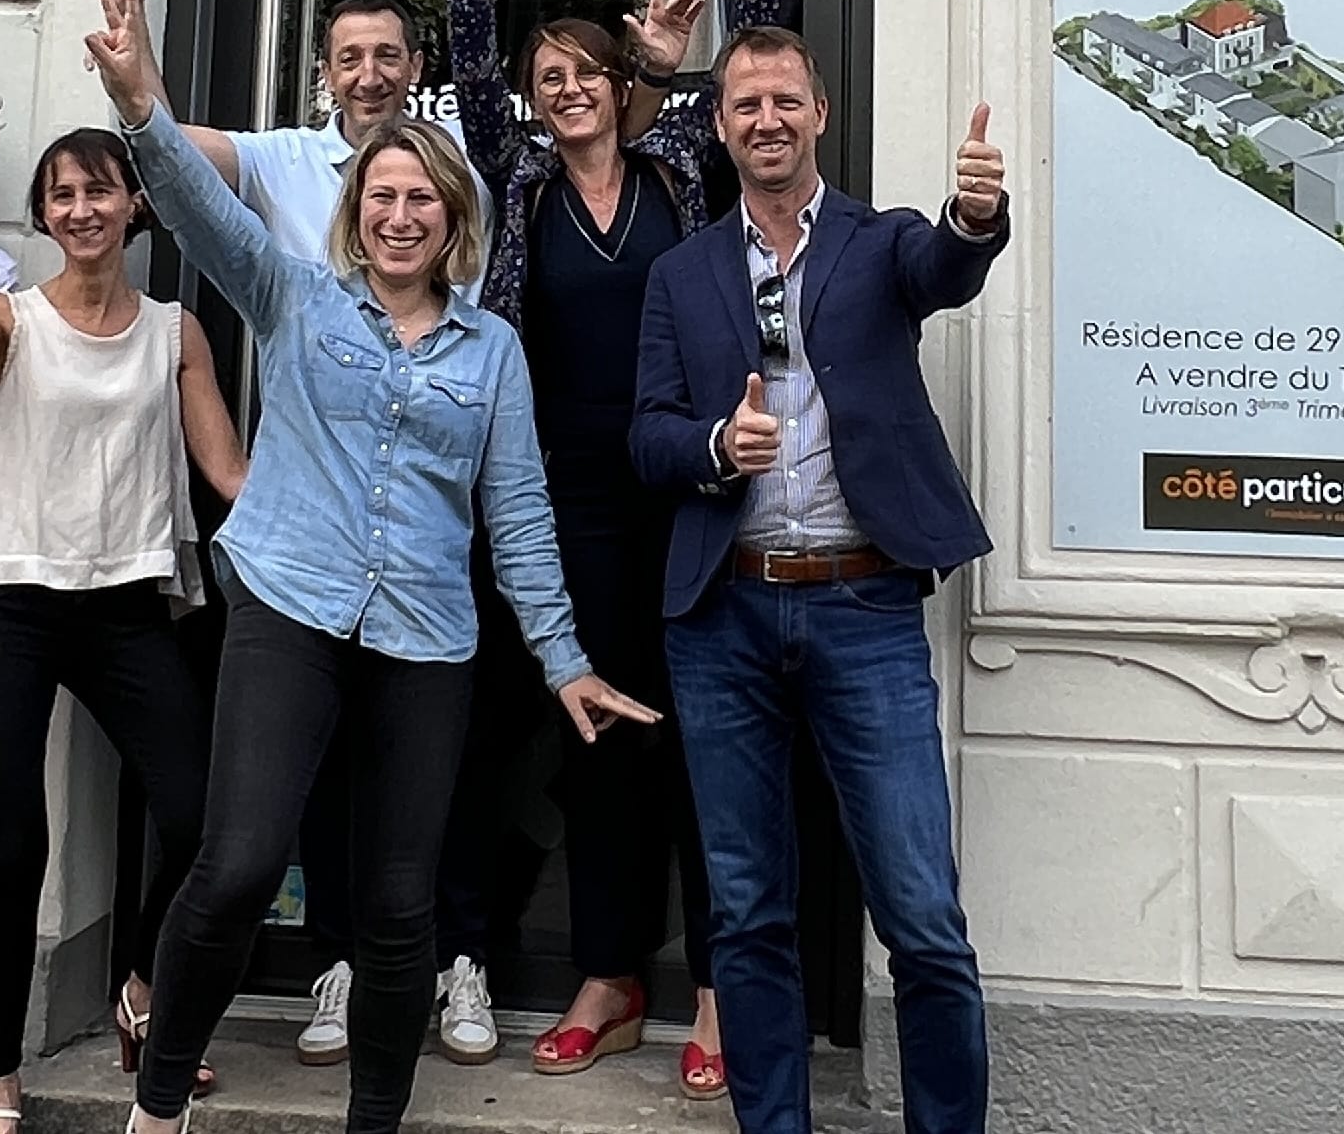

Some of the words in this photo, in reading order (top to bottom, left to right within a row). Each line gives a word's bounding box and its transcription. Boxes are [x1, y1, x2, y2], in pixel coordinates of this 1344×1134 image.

[1083, 322, 1243, 349] Résidence
[1255, 326, 1295, 351] de
[1307, 327, 1340, 351] 29
[1136, 363, 1157, 385] A
[1169, 364, 1277, 389] vendre
[1289, 366, 1328, 391] du
[1143, 397, 1237, 416] Livraison
[1163, 469, 1238, 499] côté
